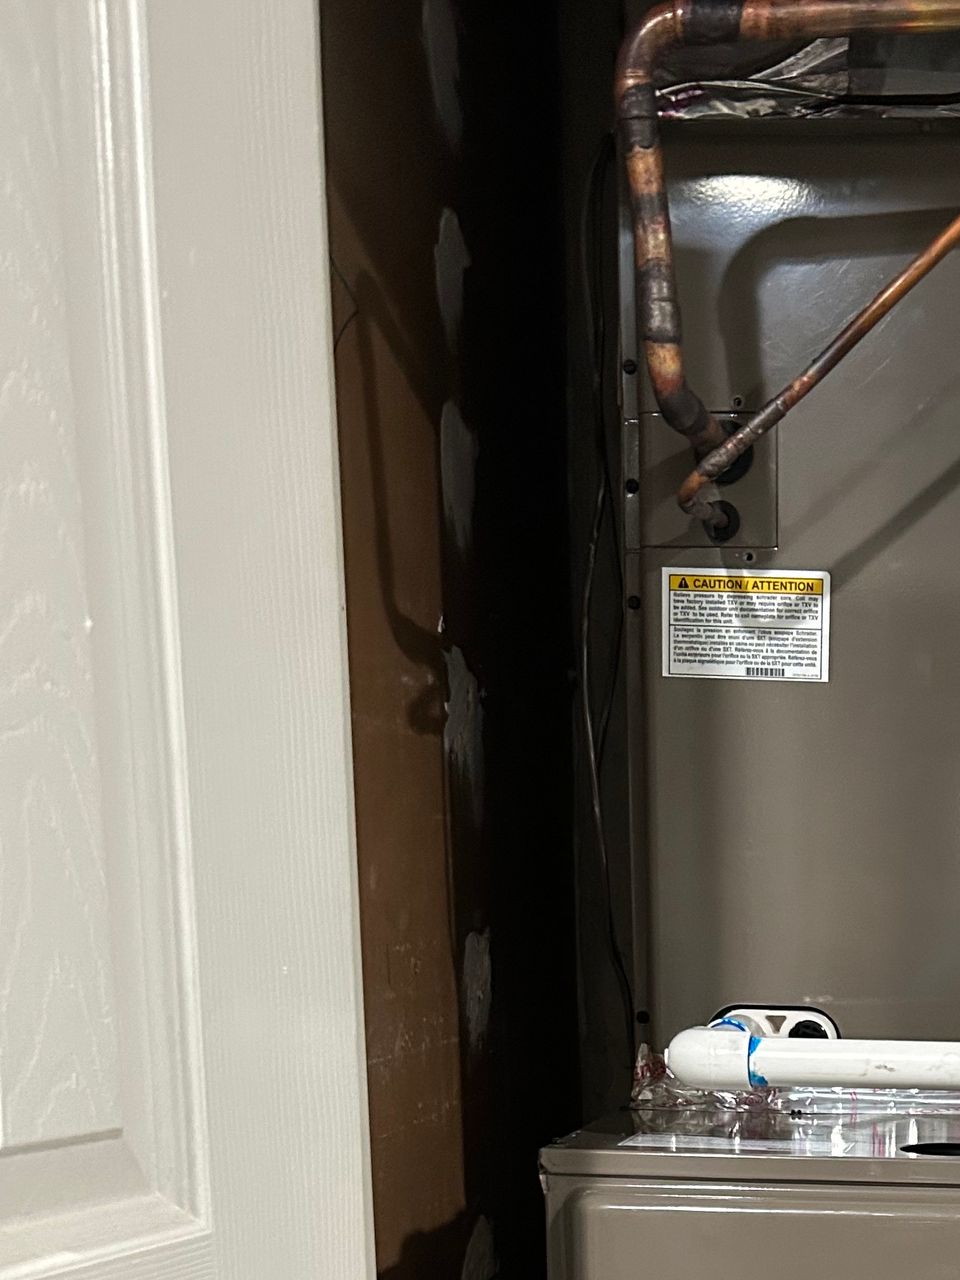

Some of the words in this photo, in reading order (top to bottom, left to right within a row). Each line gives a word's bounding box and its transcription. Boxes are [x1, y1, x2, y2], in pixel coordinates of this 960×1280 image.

[693, 578, 742, 590] CAUTION
[745, 581, 749, 591] /
[752, 580, 814, 592] ATTENTION
